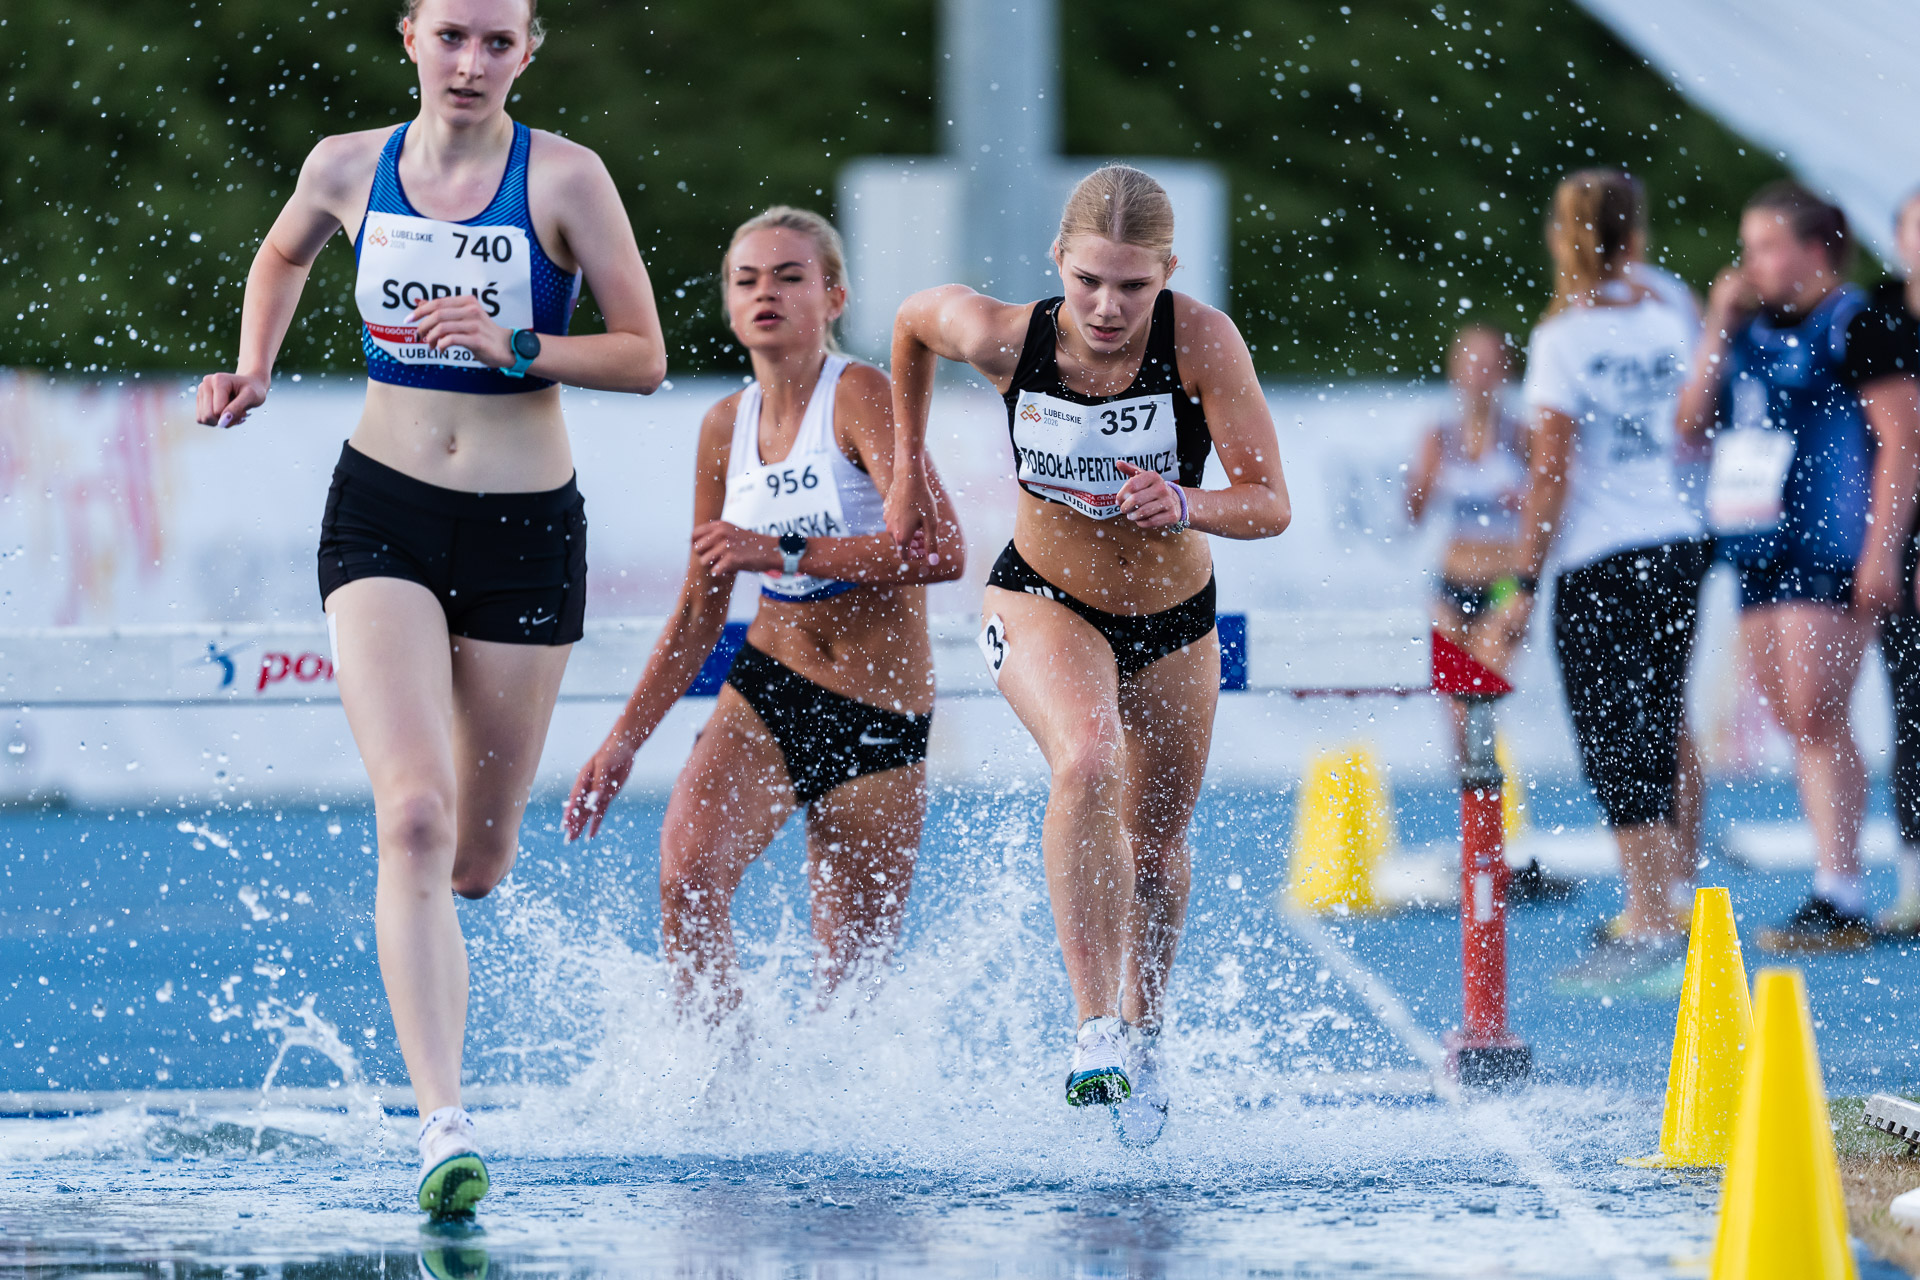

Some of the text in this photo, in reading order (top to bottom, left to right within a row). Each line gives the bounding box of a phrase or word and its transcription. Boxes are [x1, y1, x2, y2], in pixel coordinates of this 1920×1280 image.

[391, 229, 434, 243] LUBELSKIE
[452, 232, 512, 263] 740
[398, 347, 449, 360] LUBLIN
[1043, 407, 1082, 425] LUBELSKIE
[1100, 403, 1158, 436] 357
[766, 464, 818, 498] 956
[1062, 493, 1103, 517] LUBLIN
[987, 624, 1004, 670] 3
